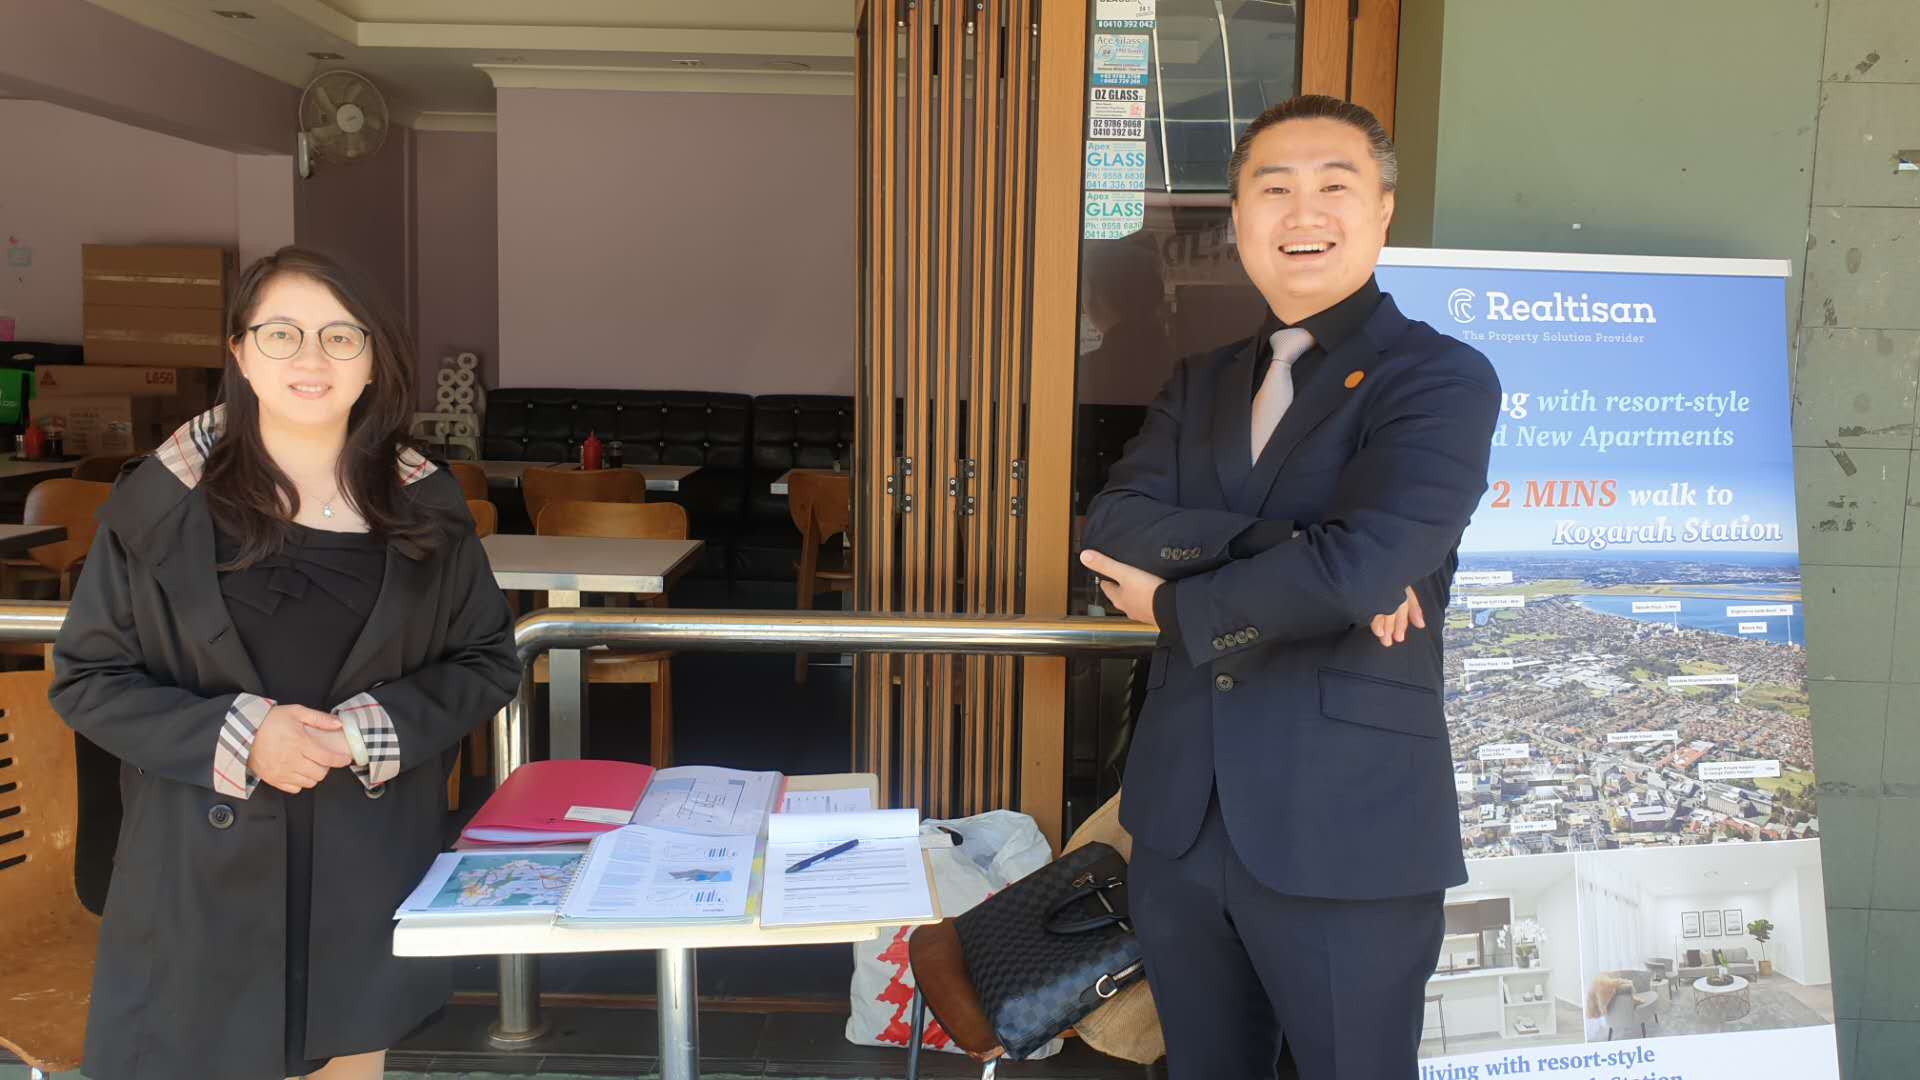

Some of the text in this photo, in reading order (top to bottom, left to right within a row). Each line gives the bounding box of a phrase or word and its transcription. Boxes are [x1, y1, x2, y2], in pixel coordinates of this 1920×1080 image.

[1095, 89, 1139, 101] OZ GLASS
[1093, 119, 1103, 128] 02
[1093, 128, 1111, 136] 0410
[1112, 128, 1126, 137] 392
[1087, 152, 1145, 167] GLASS
[1086, 202, 1143, 217] GLASS
[1486, 290, 1657, 324] Realtisan
[1462, 330, 1645, 344] The Property Solution Provider
[1536, 388, 1598, 413] with
[1605, 389, 1751, 418] resort-style
[1515, 425, 1573, 448] New
[1579, 425, 1736, 453] Apartments
[1490, 479, 1734, 509] 2 MINS walk to
[1552, 514, 1783, 551] Kogarah Station
[1421, 1046, 1656, 1080] living with resort-style
